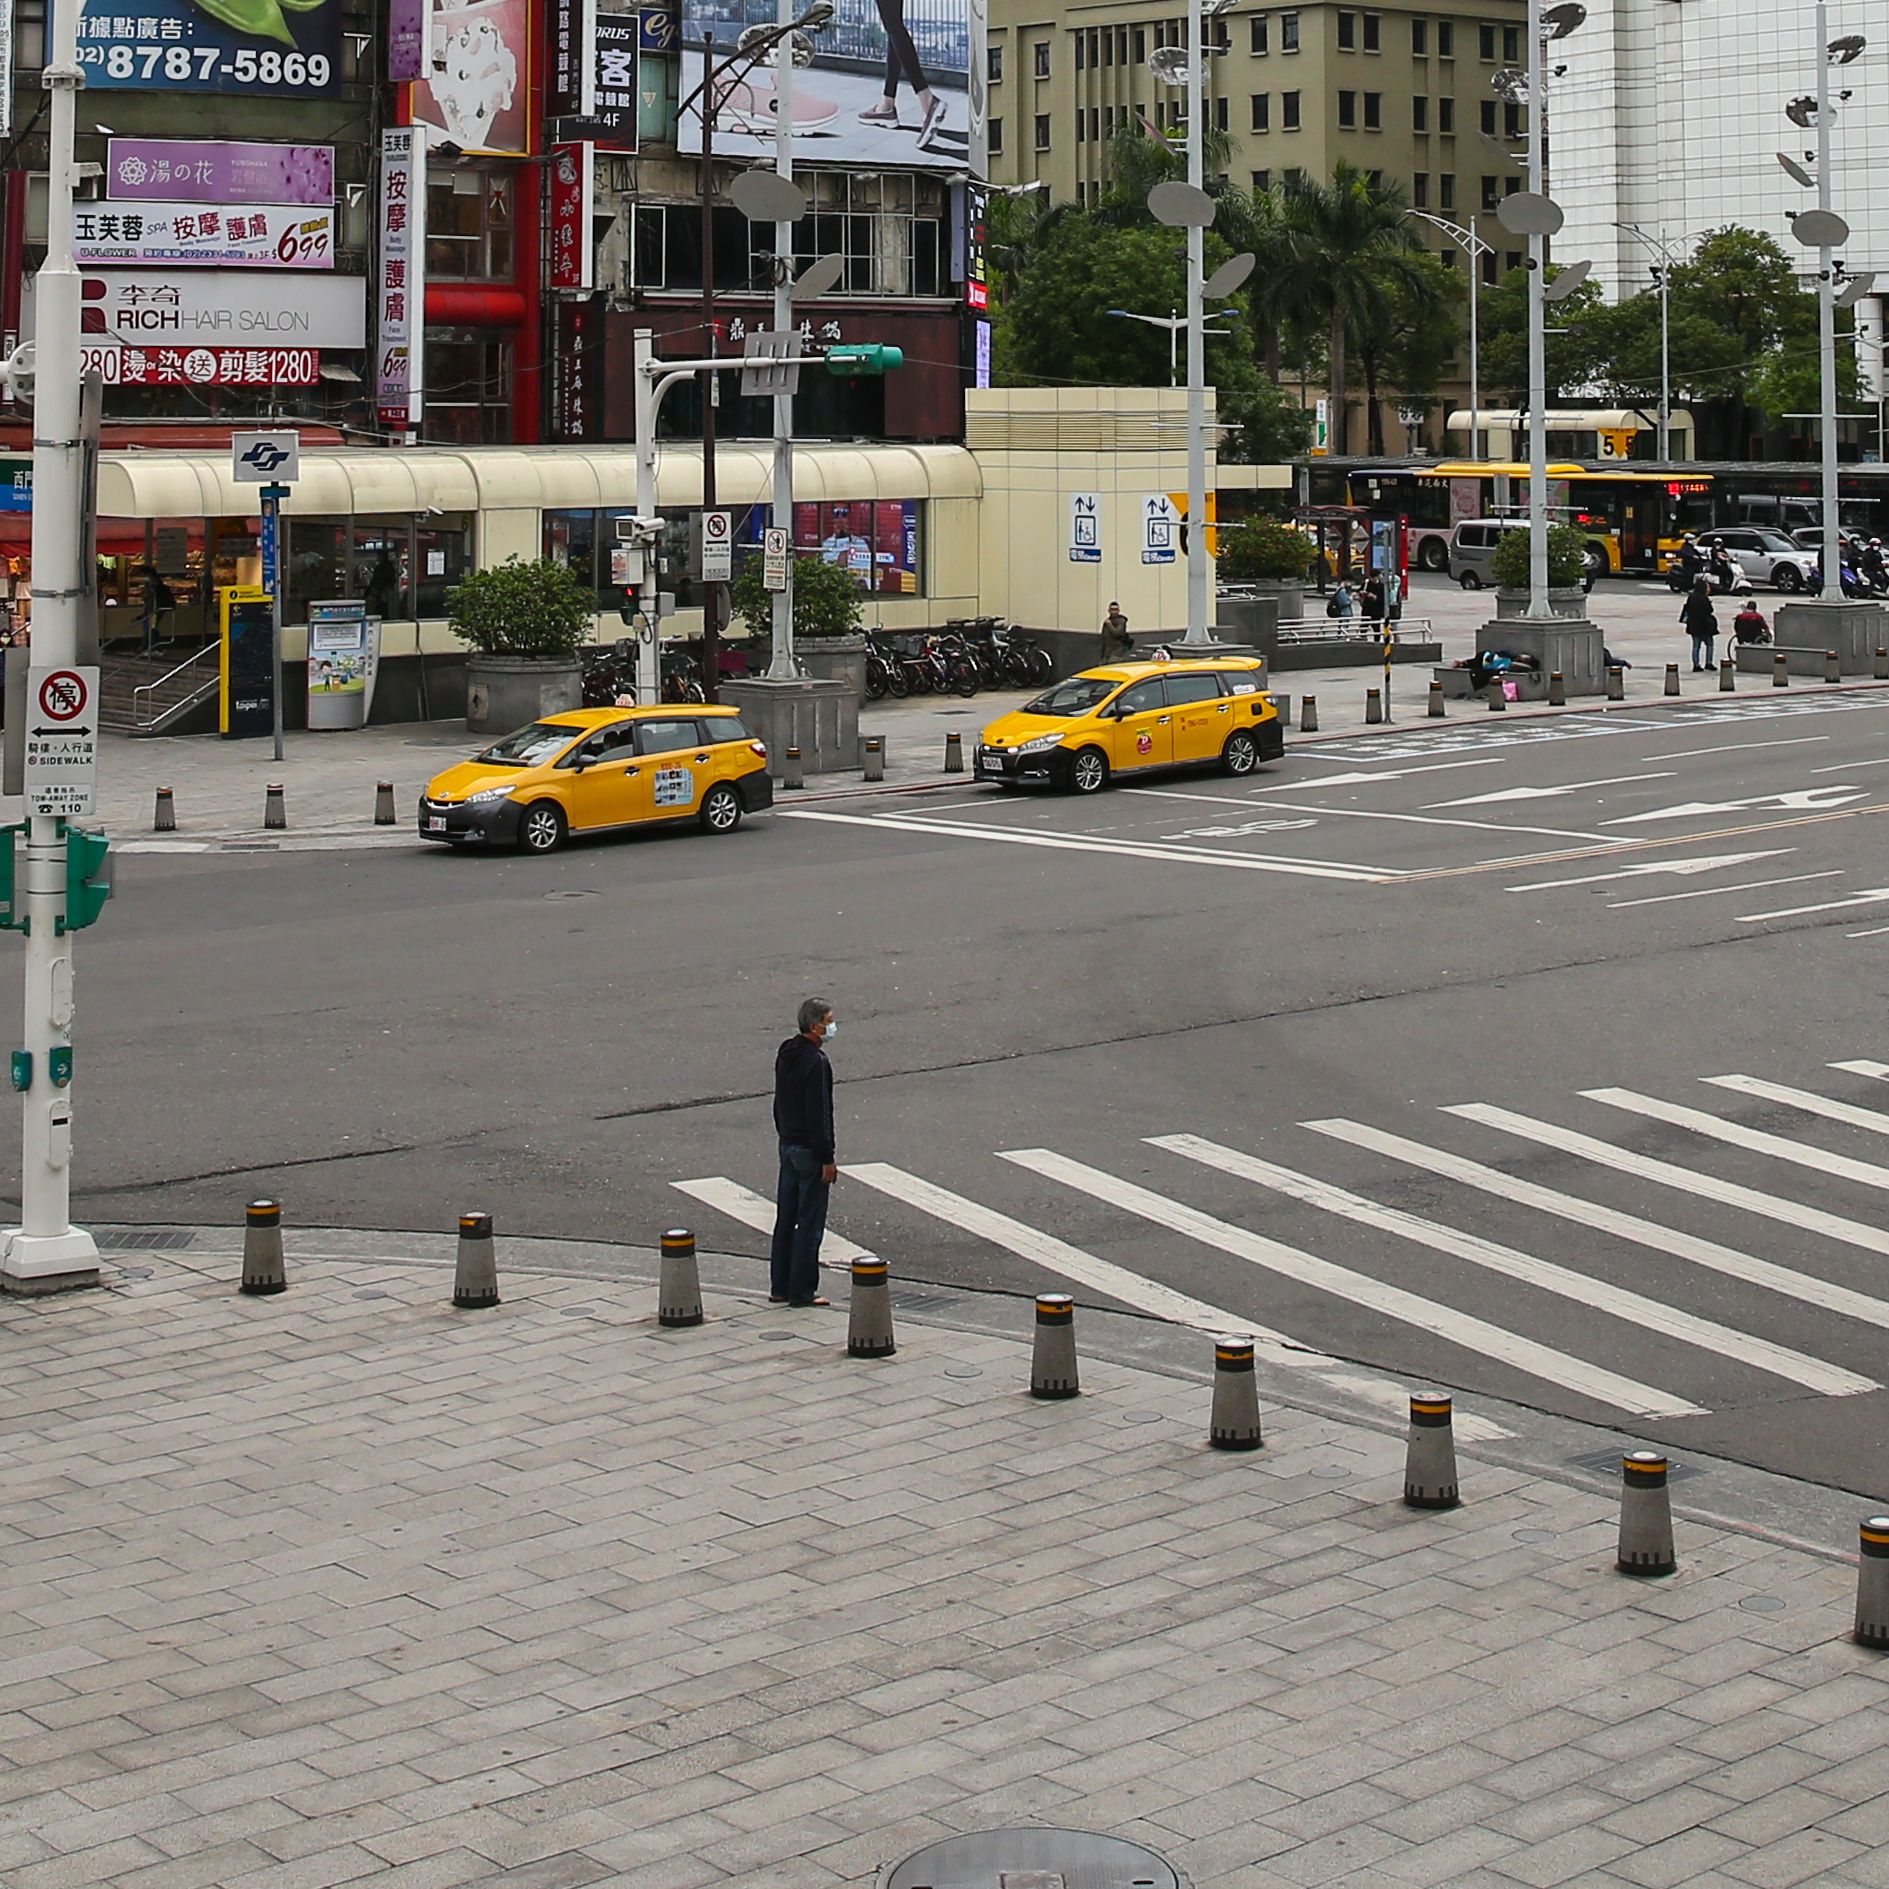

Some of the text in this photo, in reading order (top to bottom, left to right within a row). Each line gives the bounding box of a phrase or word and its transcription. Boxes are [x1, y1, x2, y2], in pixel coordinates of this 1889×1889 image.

[106, 46, 331, 89] 8787-5869
[603, 112, 620, 127] 4F
[384, 135, 411, 153] 玉芙蓉
[149, 158, 214, 186] 湯の花
[386, 171, 407, 232] 按摩
[75, 214, 144, 242] 玉芙蓉
[146, 222, 169, 236] SPA
[172, 212, 222, 241] 按摩
[226, 214, 268, 242] 護膚
[80, 249, 137, 258] U-FLOWER
[272, 223, 329, 263] $699
[117, 284, 182, 307] 李奇
[384, 259, 405, 322] 護膚
[117, 310, 310, 331] RICH HAIR SALON
[188, 354, 212, 380] 送
[219, 349, 311, 385] 剪髮1280
[1603, 435, 1614, 456] 5
[49, 682, 77, 711] 停
[40, 757, 93, 765] SIDEWALK
[60, 804, 81, 813] 110
